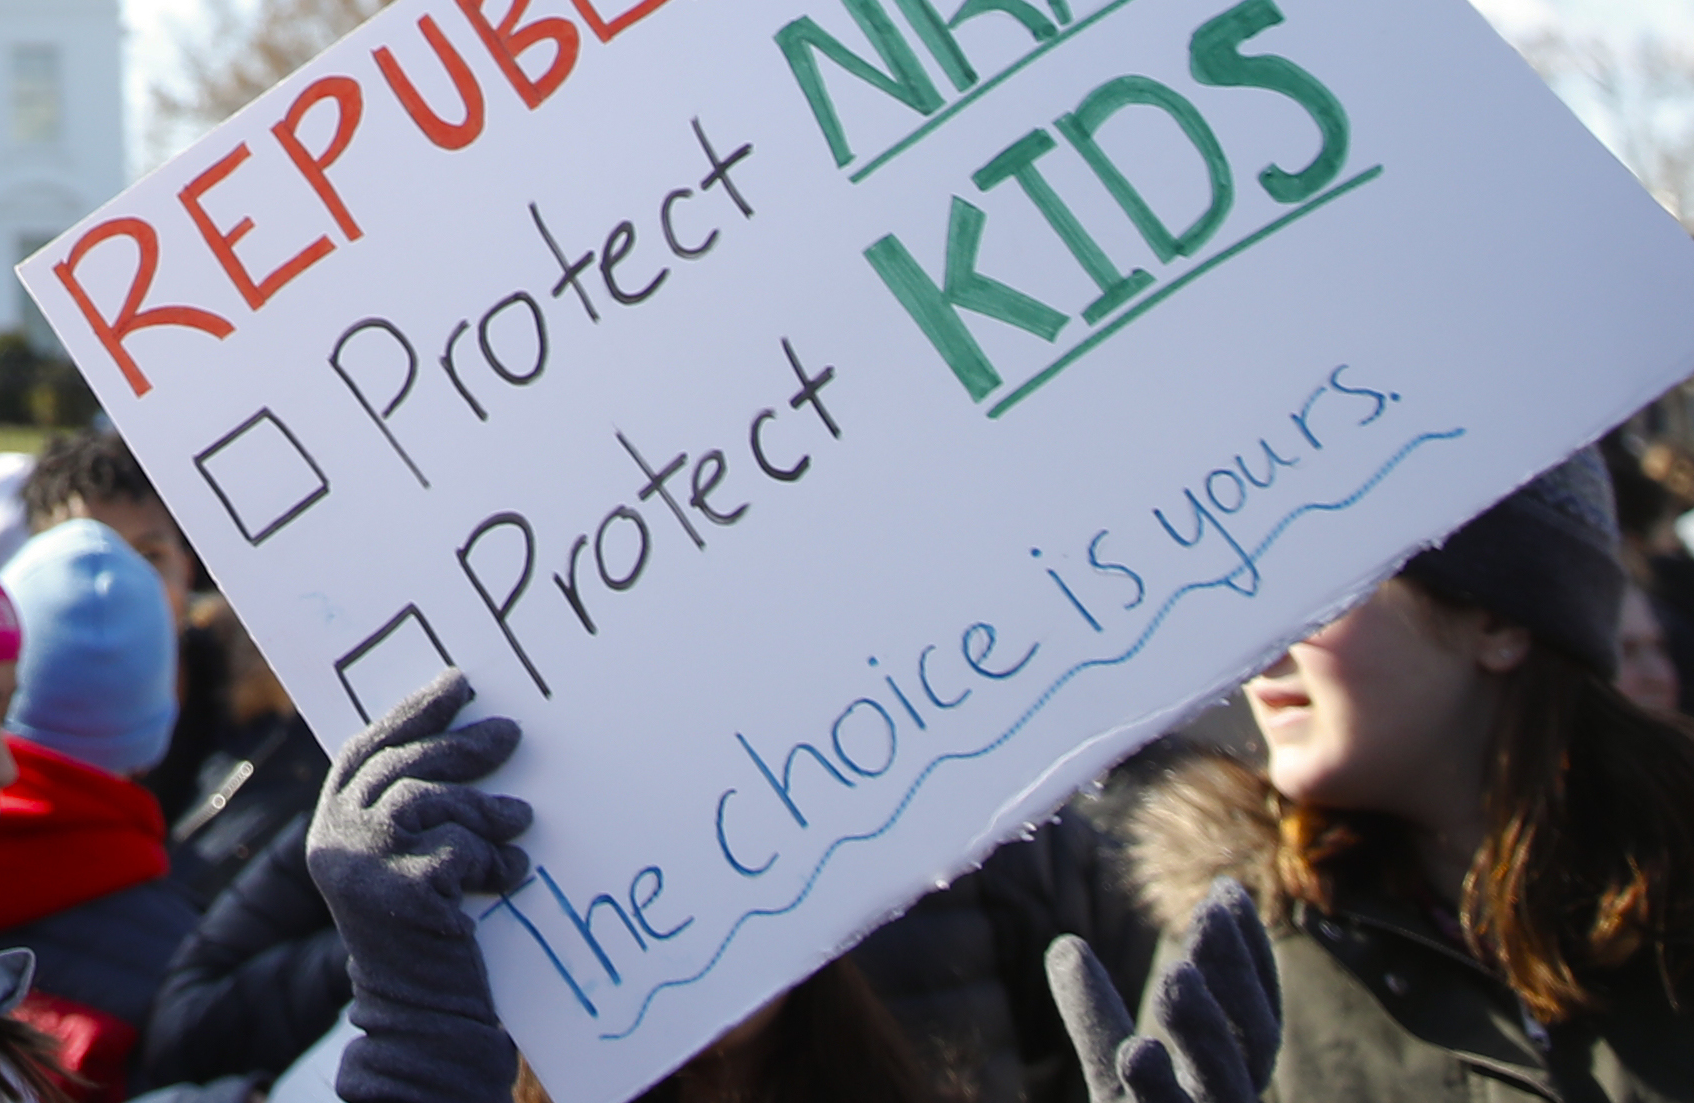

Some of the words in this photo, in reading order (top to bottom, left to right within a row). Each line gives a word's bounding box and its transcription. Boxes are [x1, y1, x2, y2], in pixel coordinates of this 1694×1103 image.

[328, 117, 754, 488] Protect
[455, 337, 843, 700] Protect
[478, 863, 695, 1019] The
[716, 622, 1040, 878] choice
[1028, 529, 1145, 634] is
[1153, 364, 1403, 597] yours.
